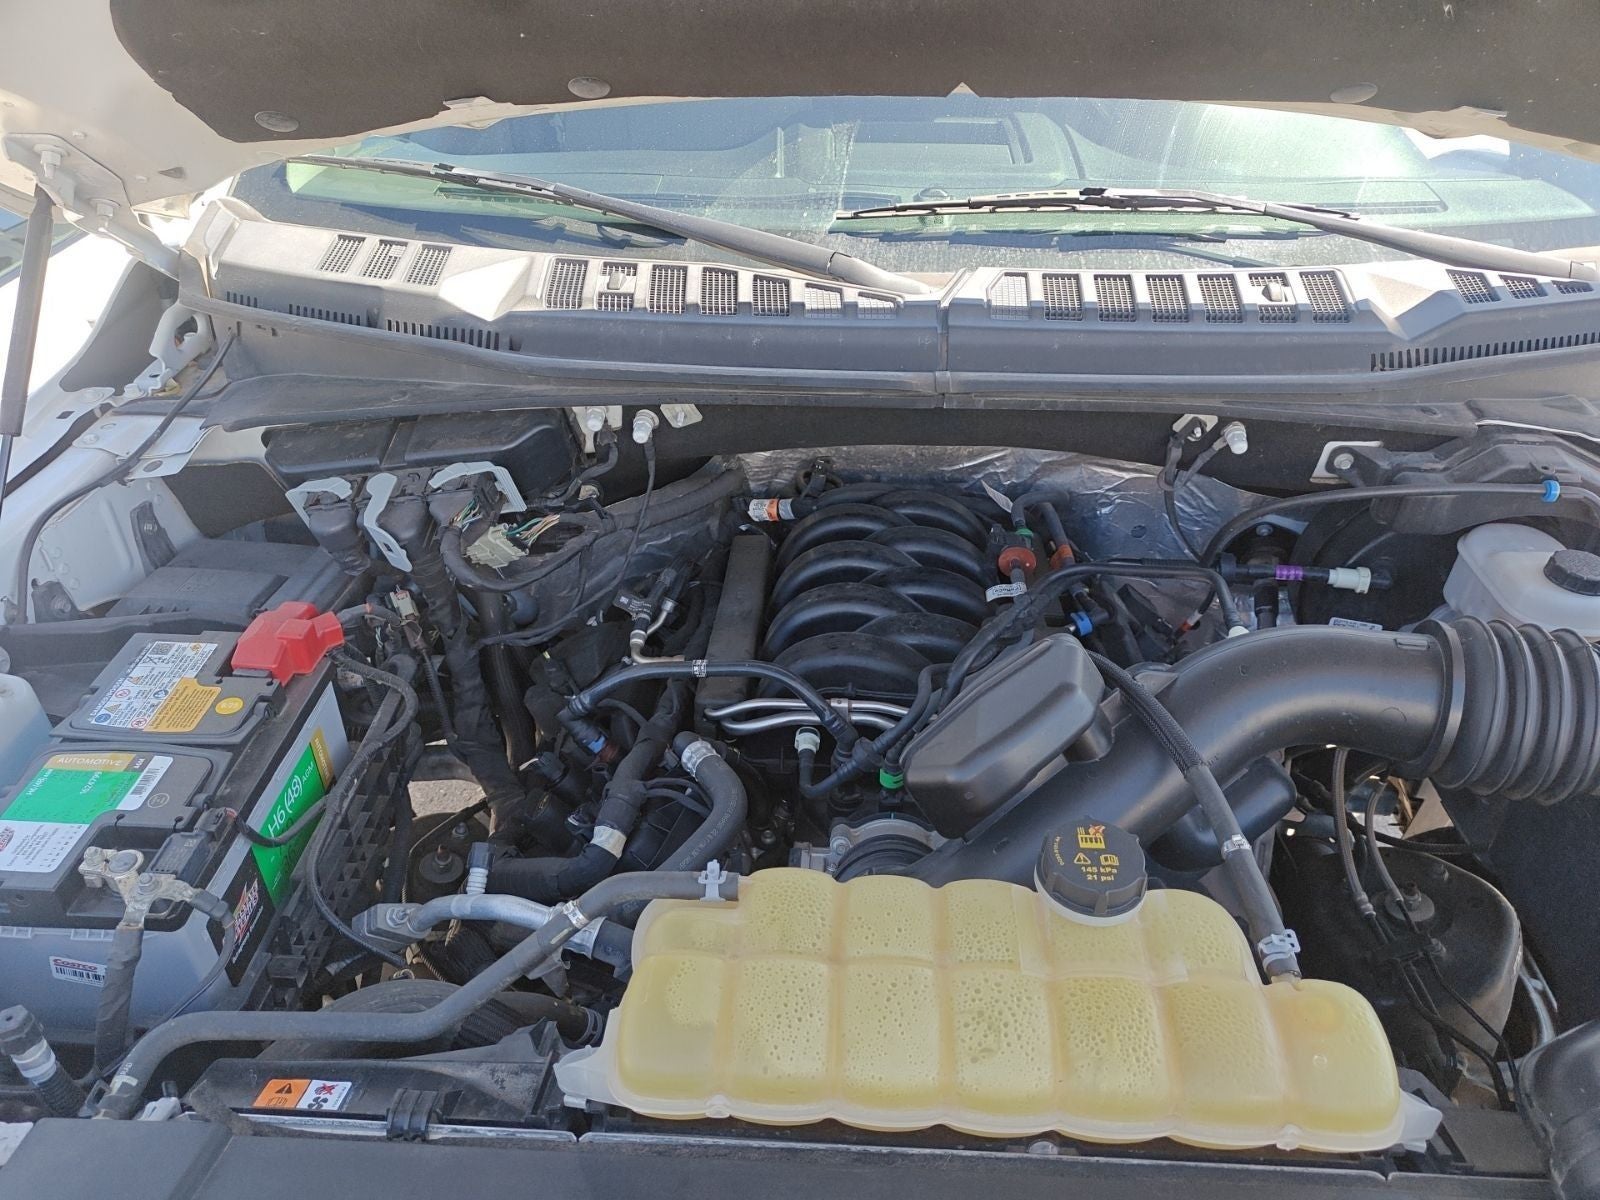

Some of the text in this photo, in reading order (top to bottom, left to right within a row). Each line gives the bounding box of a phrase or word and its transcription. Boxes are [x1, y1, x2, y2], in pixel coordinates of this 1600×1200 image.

[57, 757, 122, 766] AUTOMOTIVE
[1081, 866, 1118, 875] 145 kPa
[1100, 874, 1115, 882] psi
